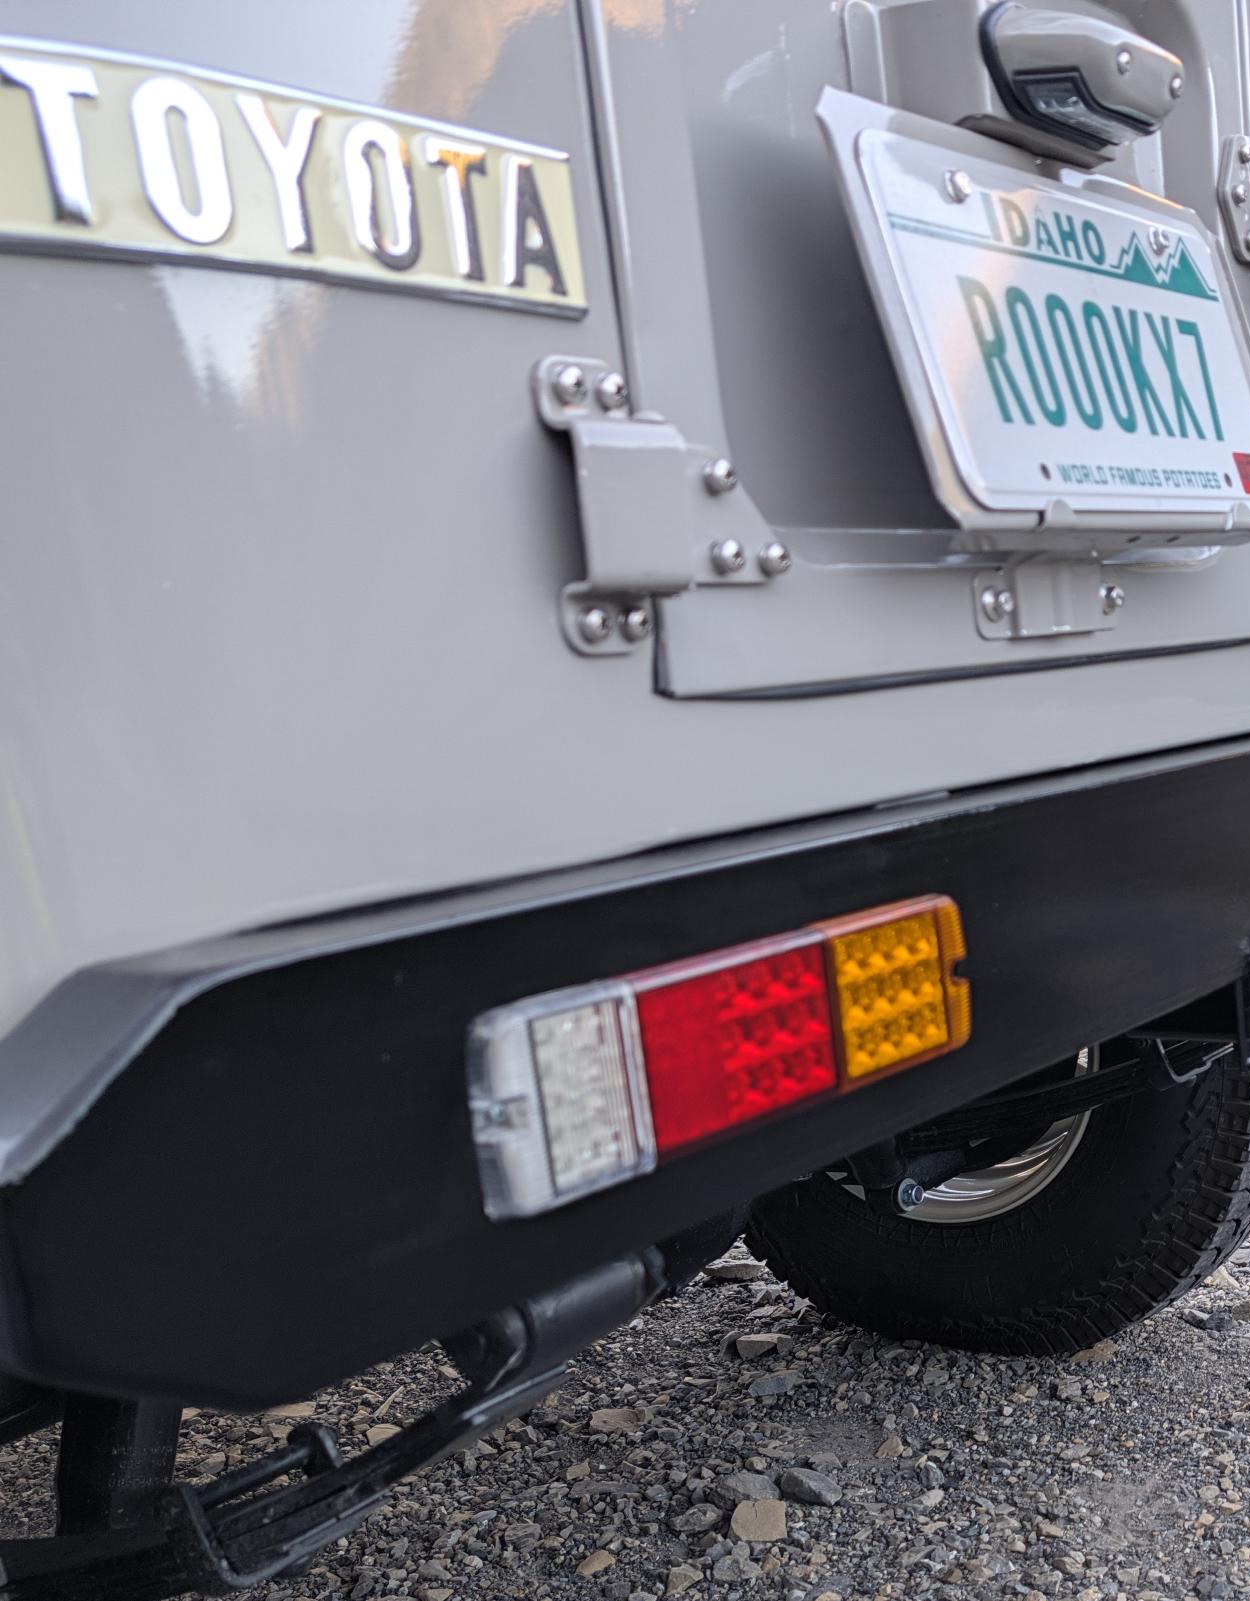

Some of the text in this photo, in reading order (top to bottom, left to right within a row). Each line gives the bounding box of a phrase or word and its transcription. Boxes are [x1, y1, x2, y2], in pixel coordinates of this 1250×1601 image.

[0, 56, 567, 296] TOYOTA
[979, 191, 1106, 265] IDAHO
[1056, 464, 1222, 490] WORLD FAMOUS POTATOES
